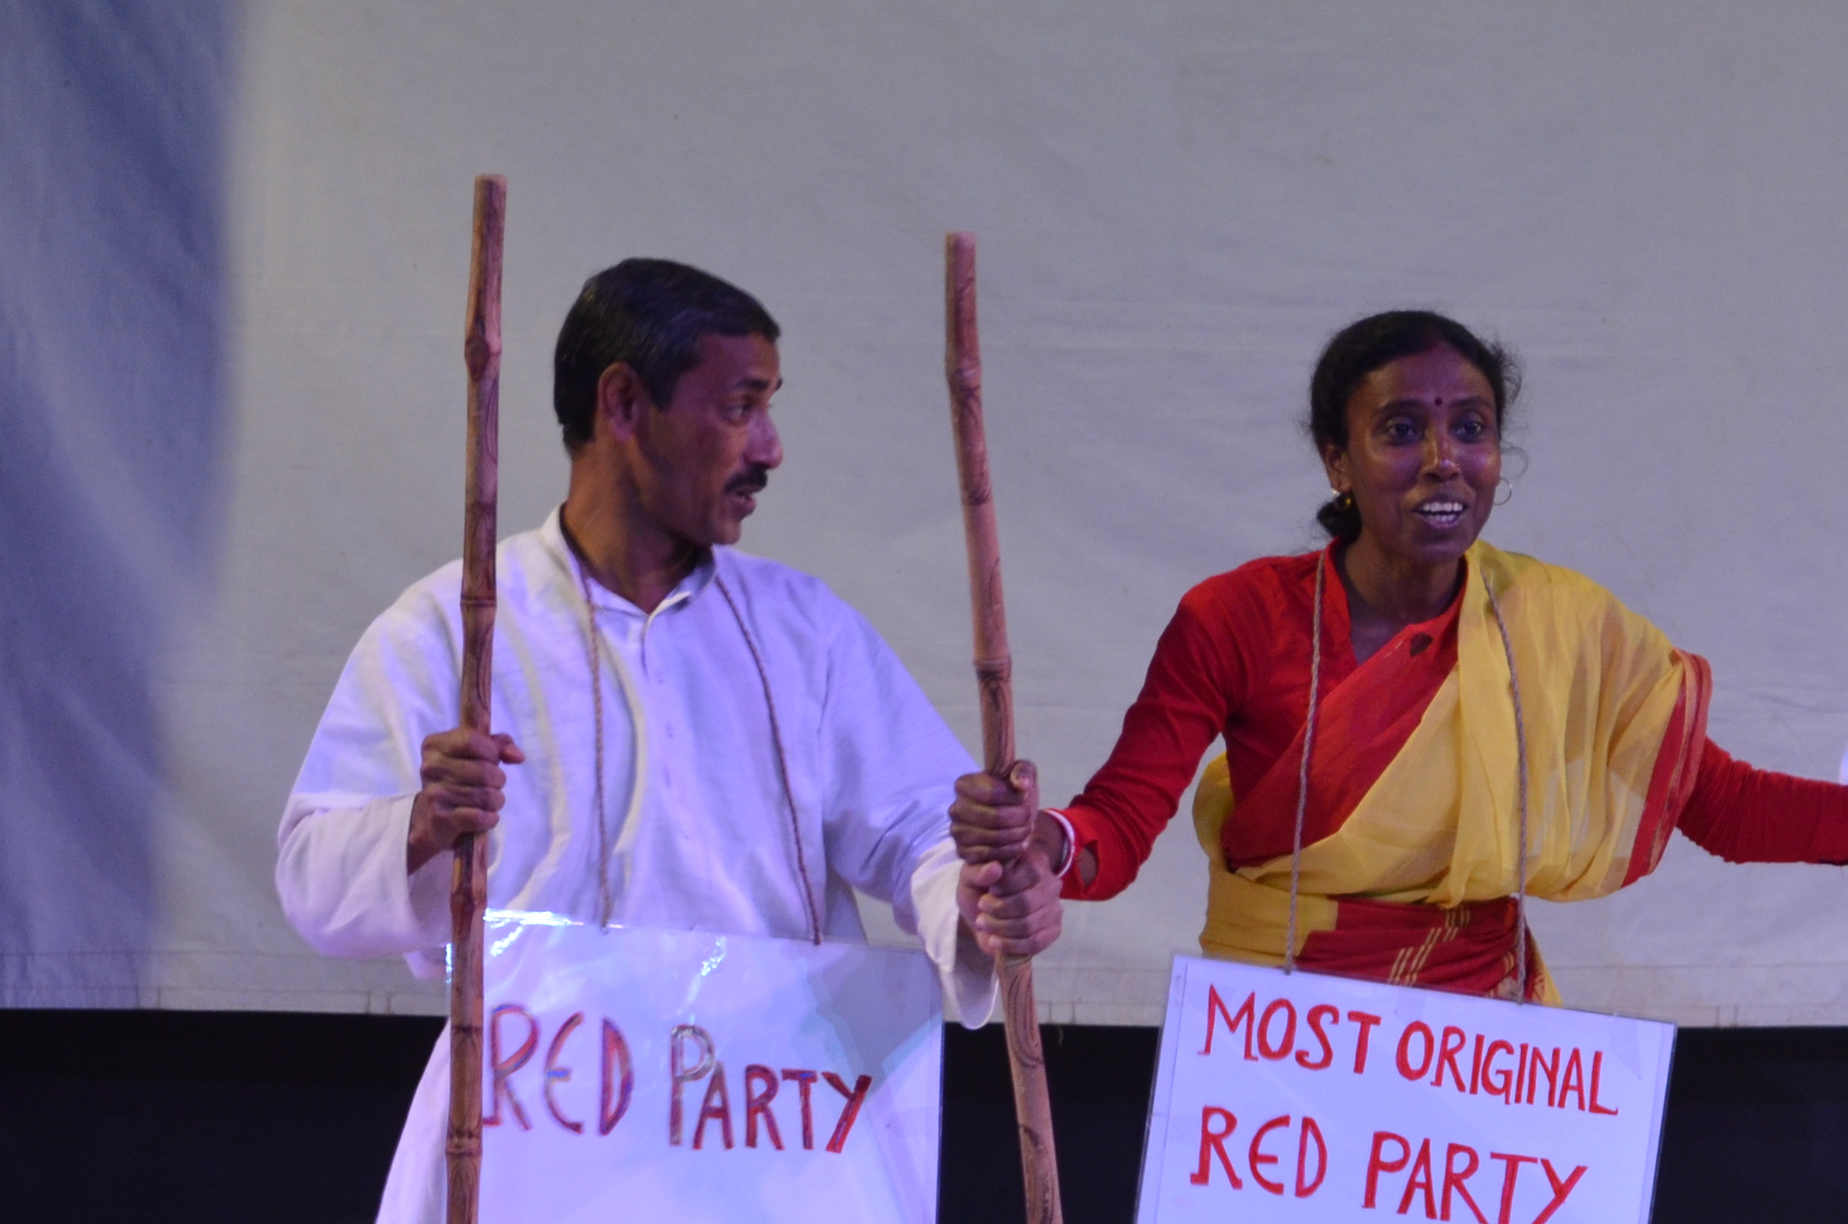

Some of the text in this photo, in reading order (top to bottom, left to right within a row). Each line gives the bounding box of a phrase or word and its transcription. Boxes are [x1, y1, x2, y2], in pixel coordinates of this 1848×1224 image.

[482, 1003, 873, 1154] RED PARTY
[1197, 983, 1619, 1116] MOST ORIGINAL
[1189, 1105, 1328, 1199] RED
